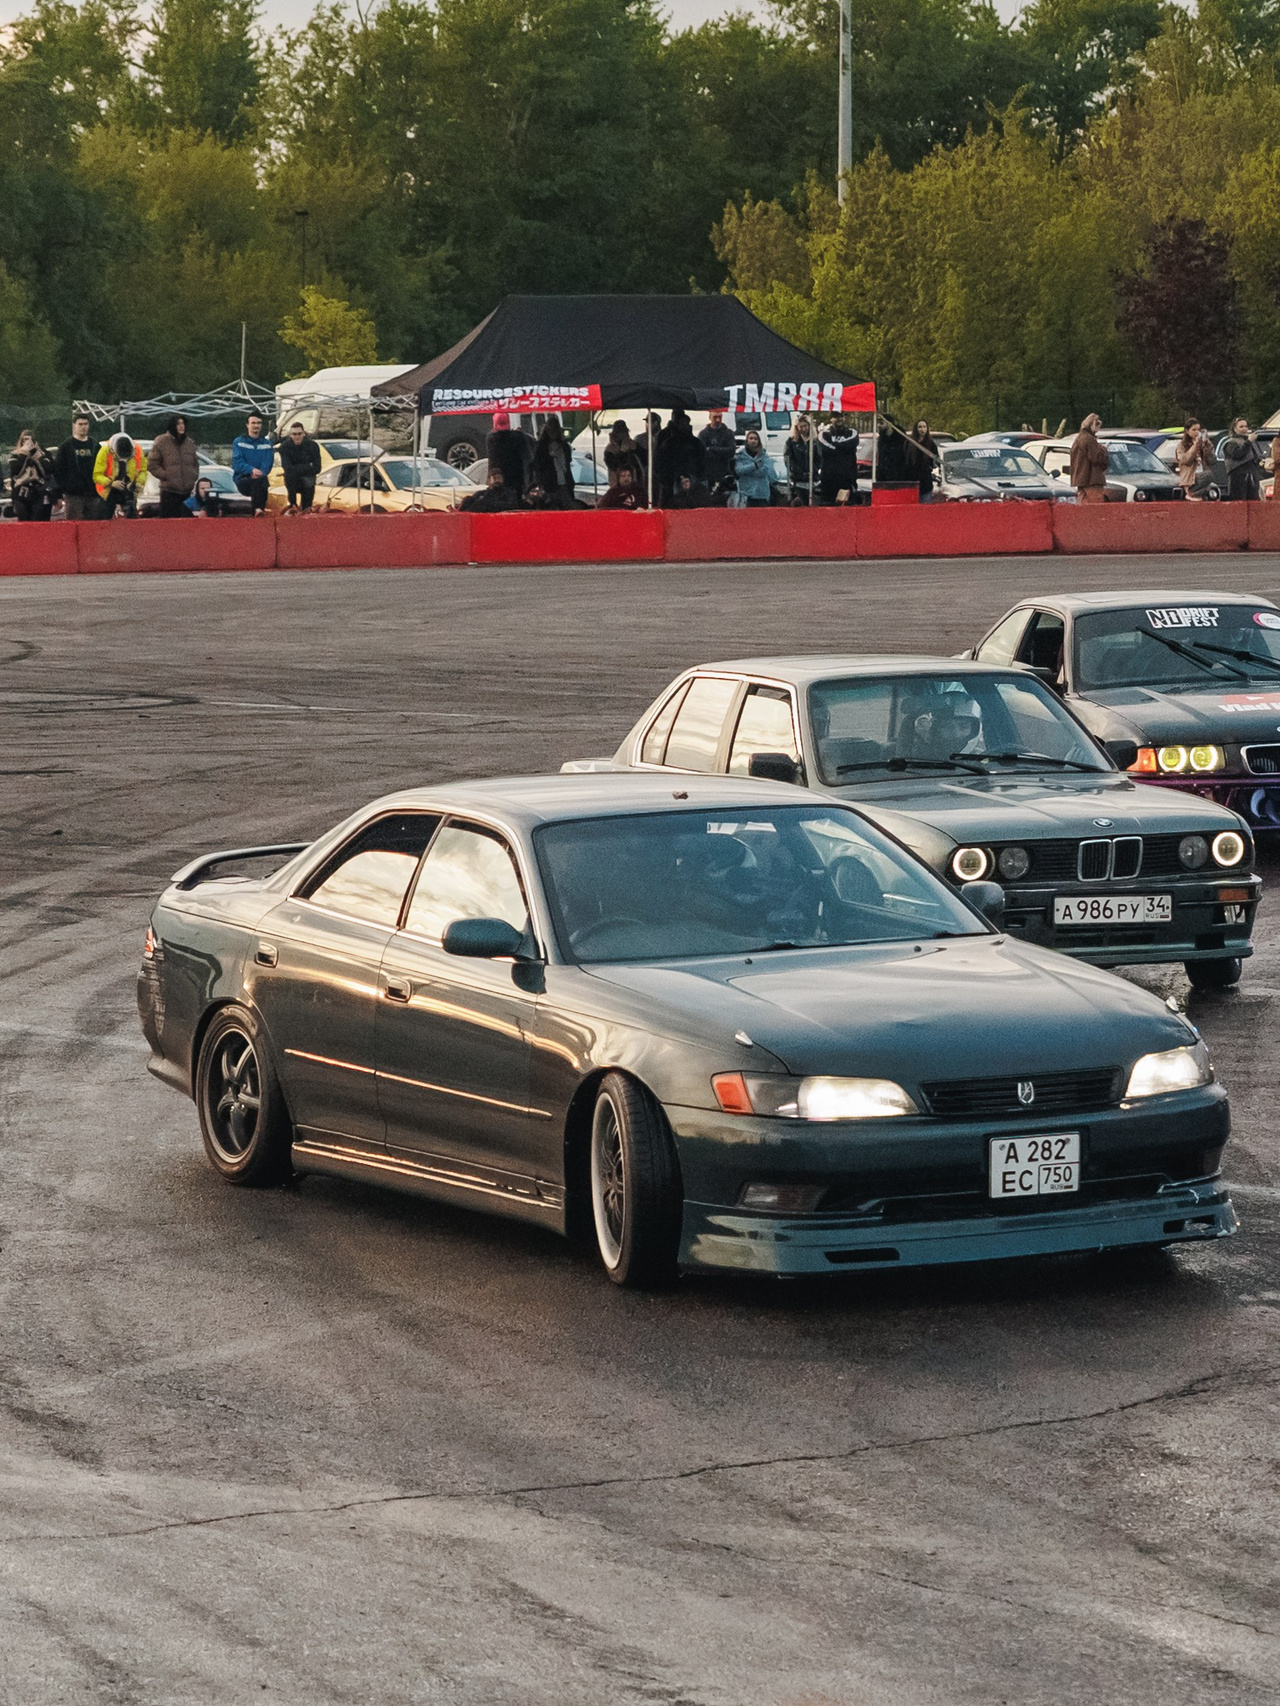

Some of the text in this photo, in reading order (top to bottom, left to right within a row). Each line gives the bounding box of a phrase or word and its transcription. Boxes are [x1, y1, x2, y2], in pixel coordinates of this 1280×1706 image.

[433, 385, 589, 400] RESOURCESTICKERS
[724, 382, 843, 413] TMR88
[1180, 608, 1219, 618] DRIFT
[1185, 617, 1218, 627] FEST
[1218, 703, 1272, 713] Vlad
[1146, 897, 1165, 912] 34
[1027, 1139, 1066, 1163] 282
[1042, 1165, 1073, 1184] 750
